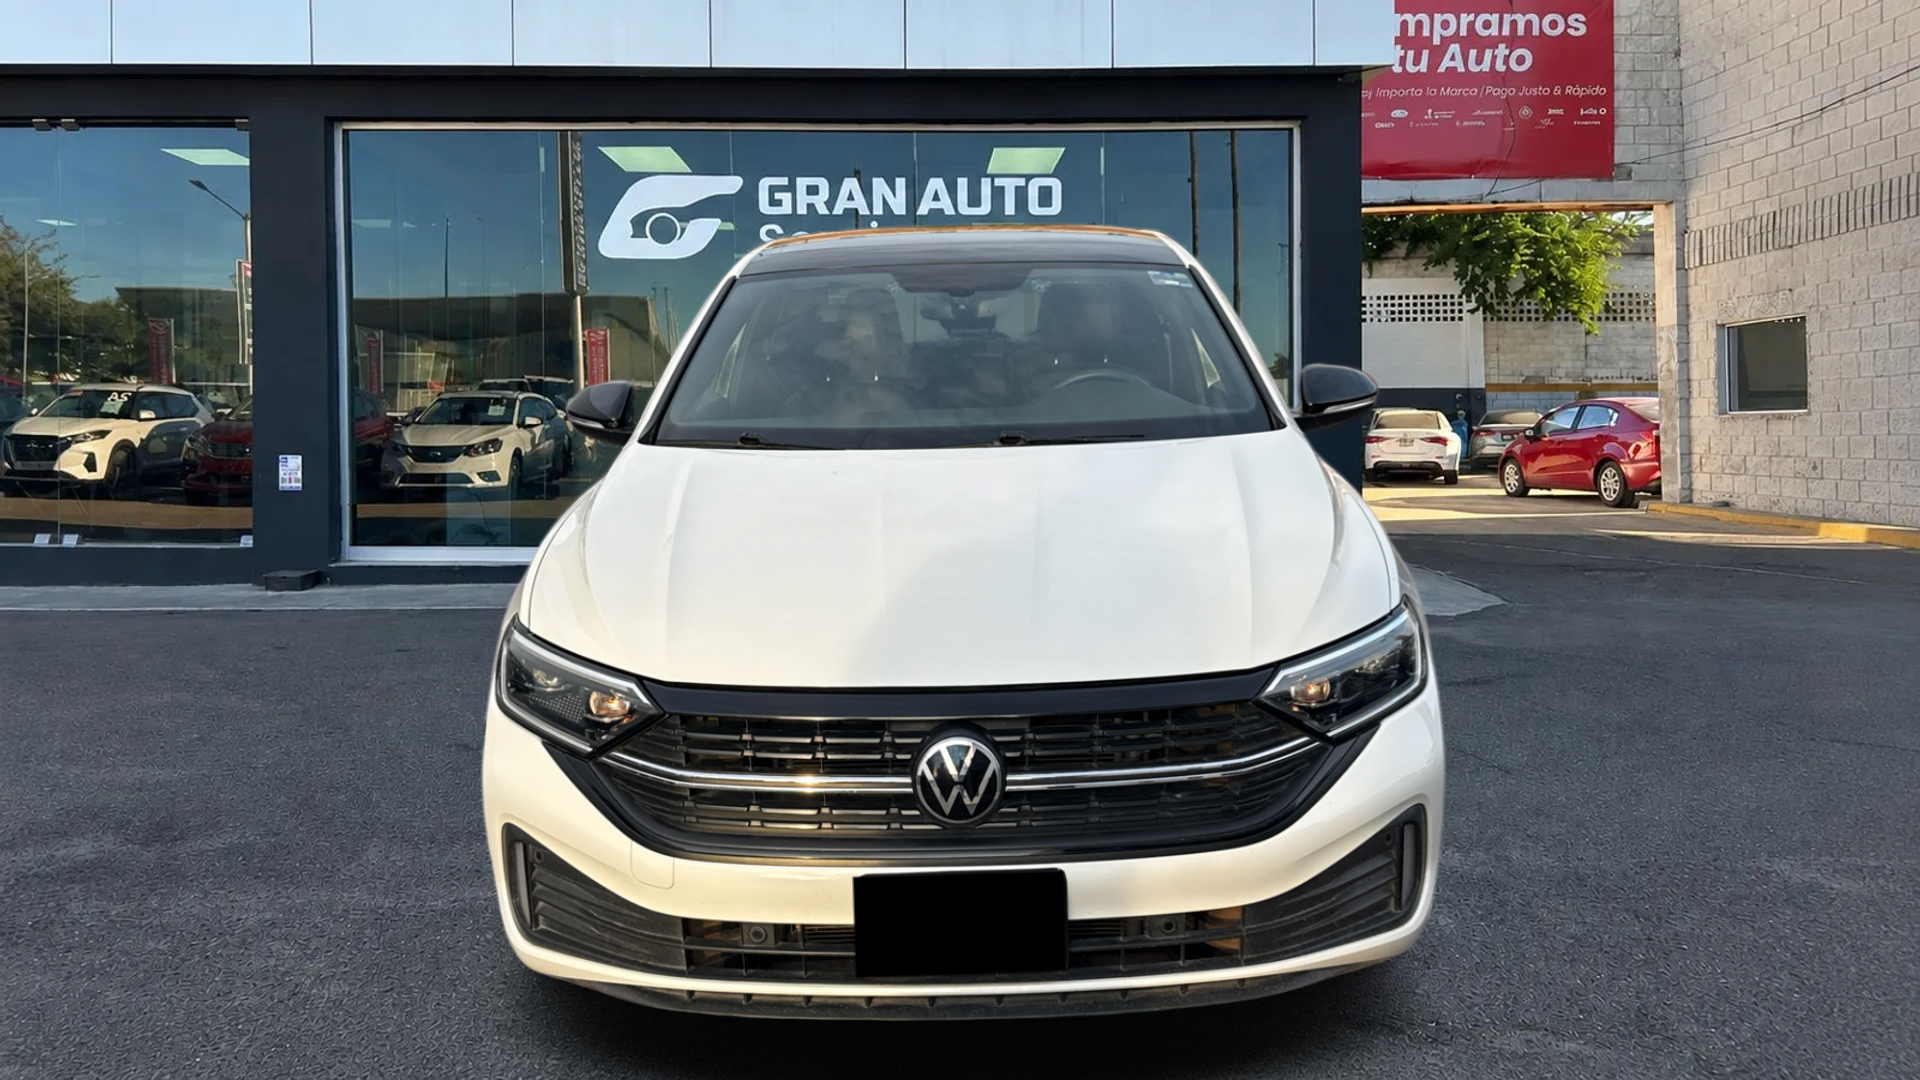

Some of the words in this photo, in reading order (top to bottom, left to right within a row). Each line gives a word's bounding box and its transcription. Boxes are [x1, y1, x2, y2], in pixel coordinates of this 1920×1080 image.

[1392, 44, 1430, 73] tu
[1437, 43, 1533, 73] Auto
[1376, 87, 1423, 99] Importa
[1426, 86, 1437, 97] la
[1440, 86, 1478, 97] Marca
[1519, 85, 1551, 96] Justo
[1553, 85, 1562, 95] &
[1564, 84, 1607, 98] Rápido
[758, 177, 907, 215] GRAN
[918, 177, 1062, 215] AUTO
